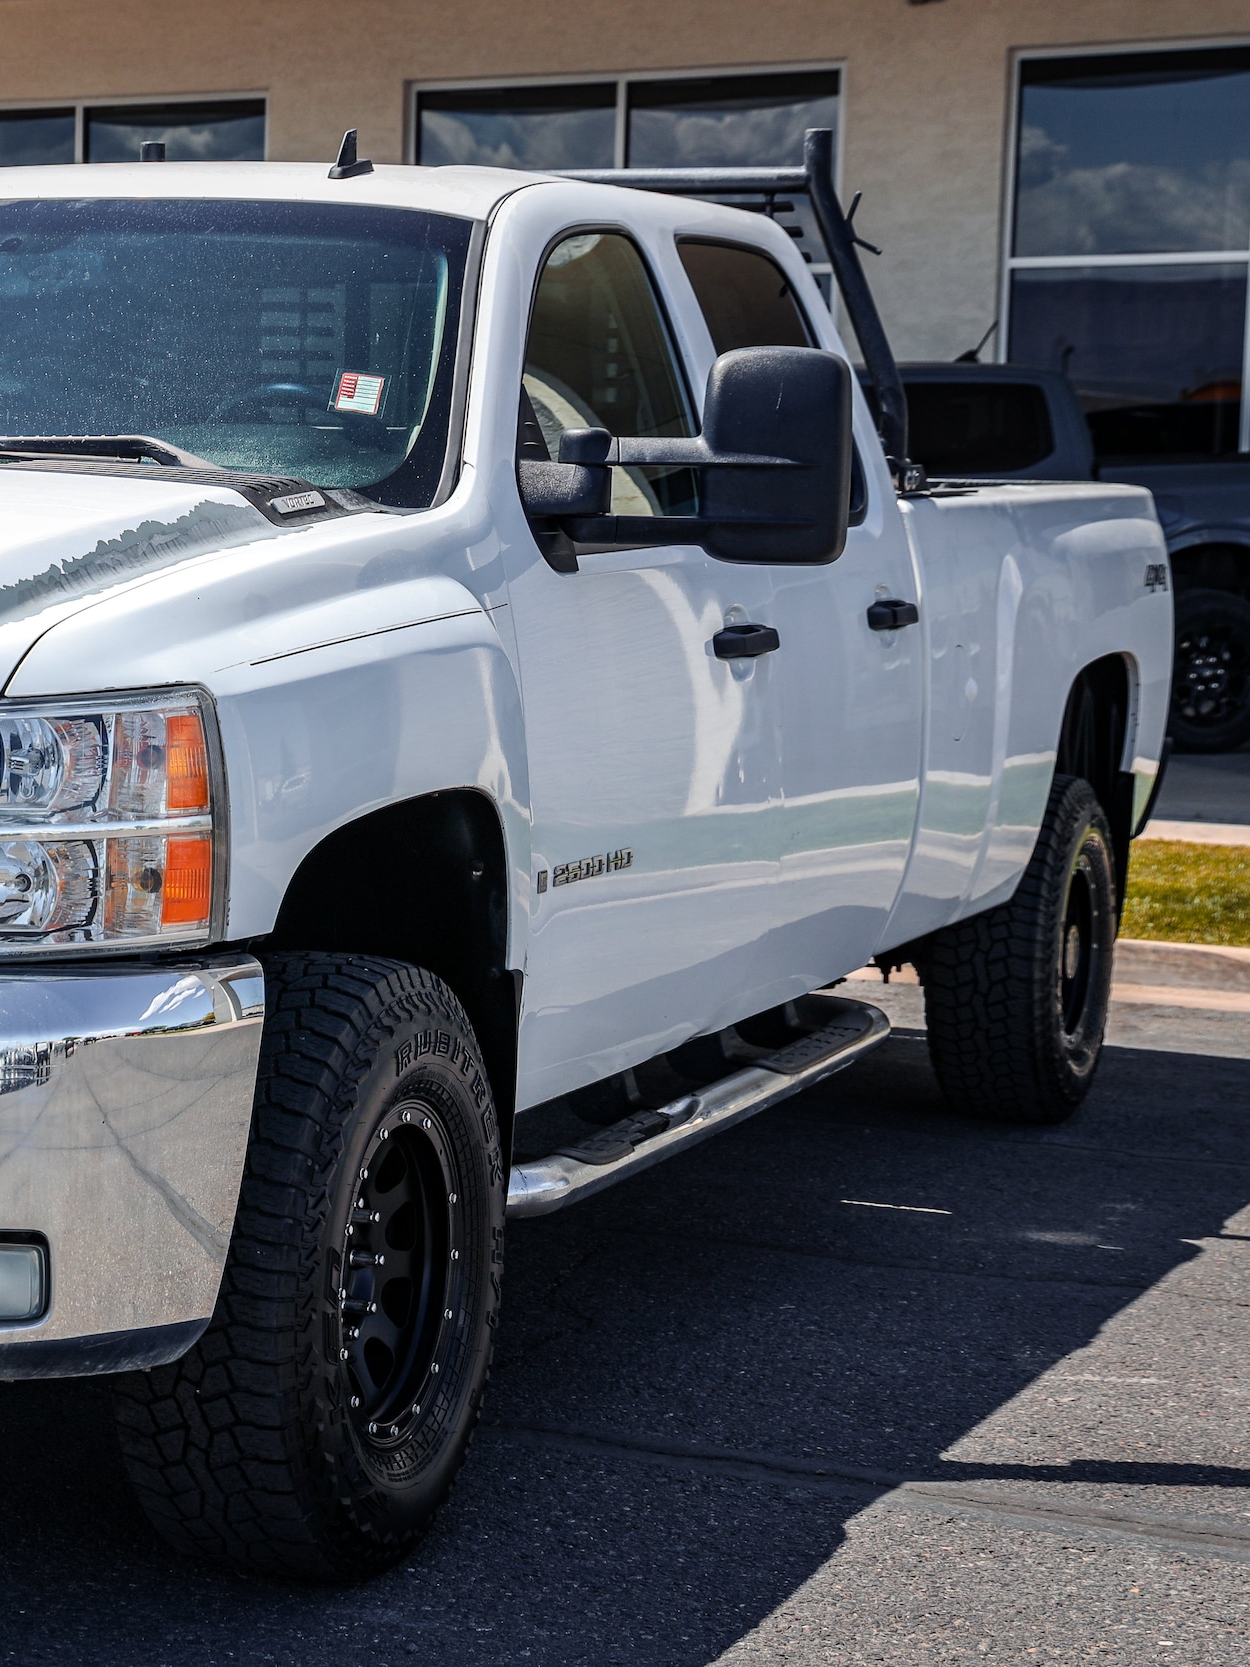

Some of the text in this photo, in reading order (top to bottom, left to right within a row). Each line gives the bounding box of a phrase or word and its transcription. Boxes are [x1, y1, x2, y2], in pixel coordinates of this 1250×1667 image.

[281, 494, 315, 509] VORTEC
[553, 847, 633, 887] 2500 HD
[396, 1029, 503, 1187] RUBITREK
